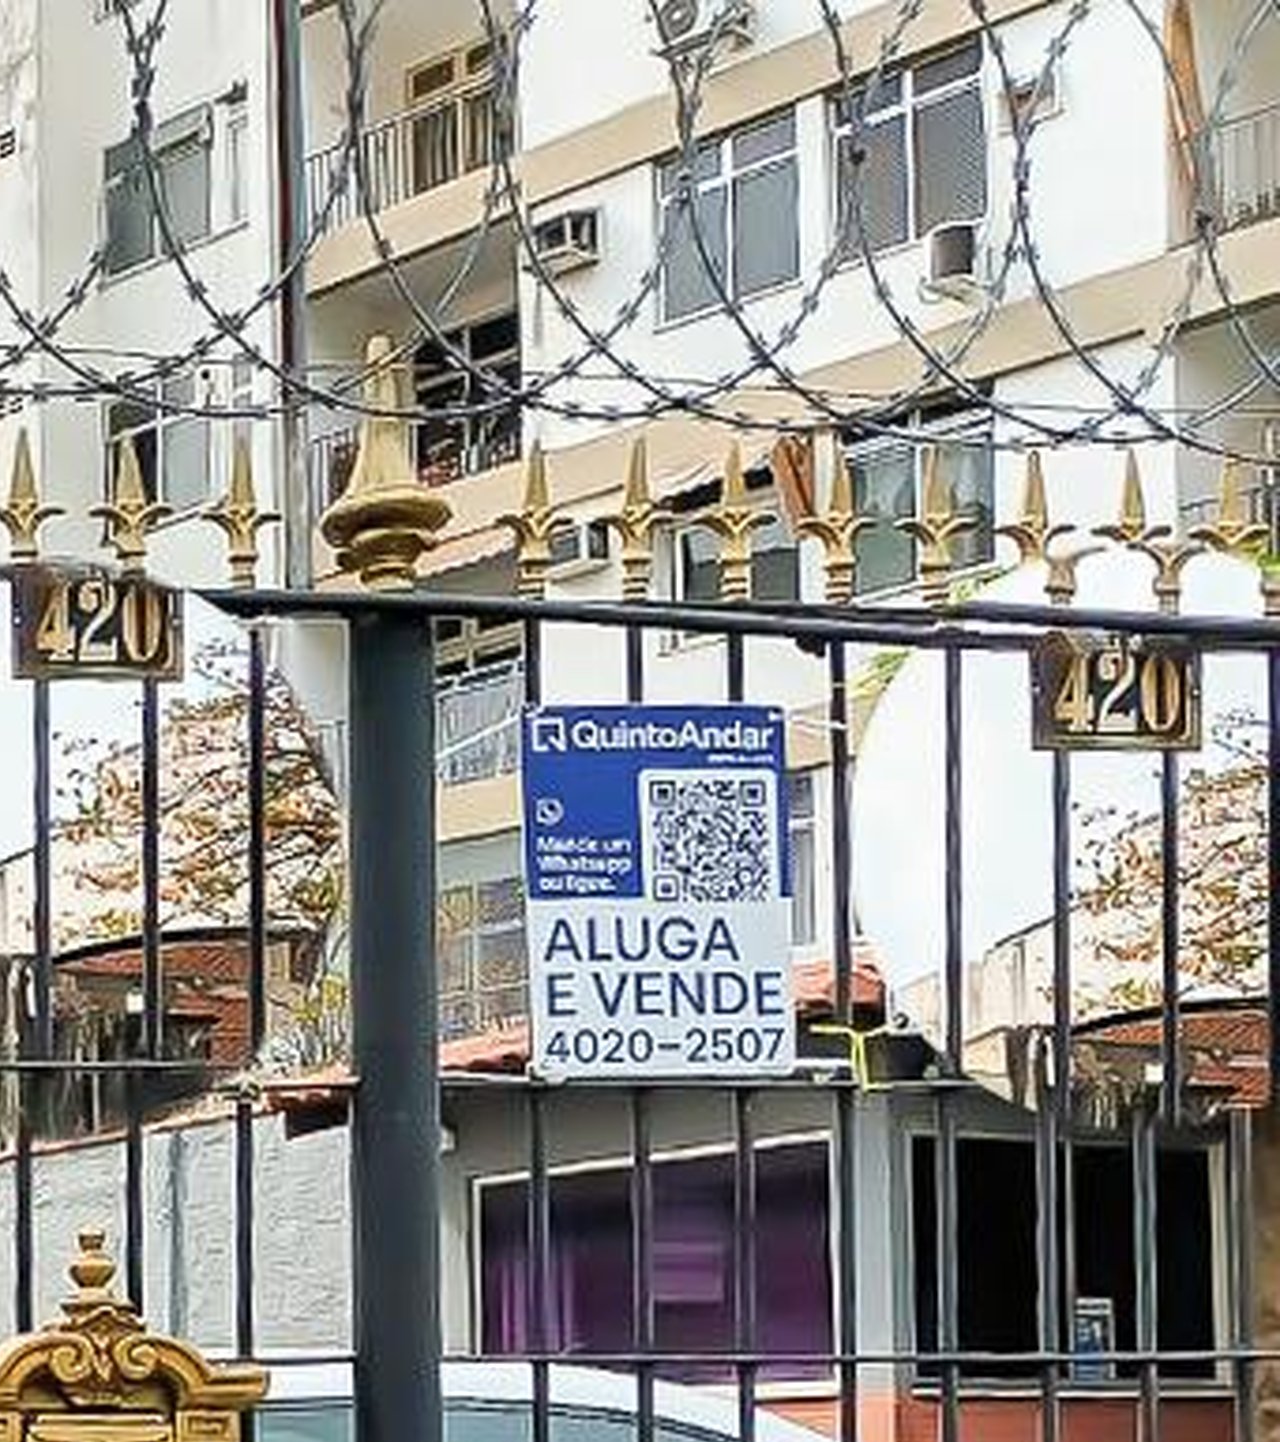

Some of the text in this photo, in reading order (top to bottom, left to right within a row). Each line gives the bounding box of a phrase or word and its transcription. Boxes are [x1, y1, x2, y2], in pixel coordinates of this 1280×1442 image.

[36, 579, 161, 661] 420
[1054, 652, 1179, 733] 420
[571, 719, 774, 750] QuintoAndar
[544, 917, 740, 962] ALUGA
[547, 971, 784, 1017] E VENDE
[545, 1028, 785, 1064] 4020-2507
